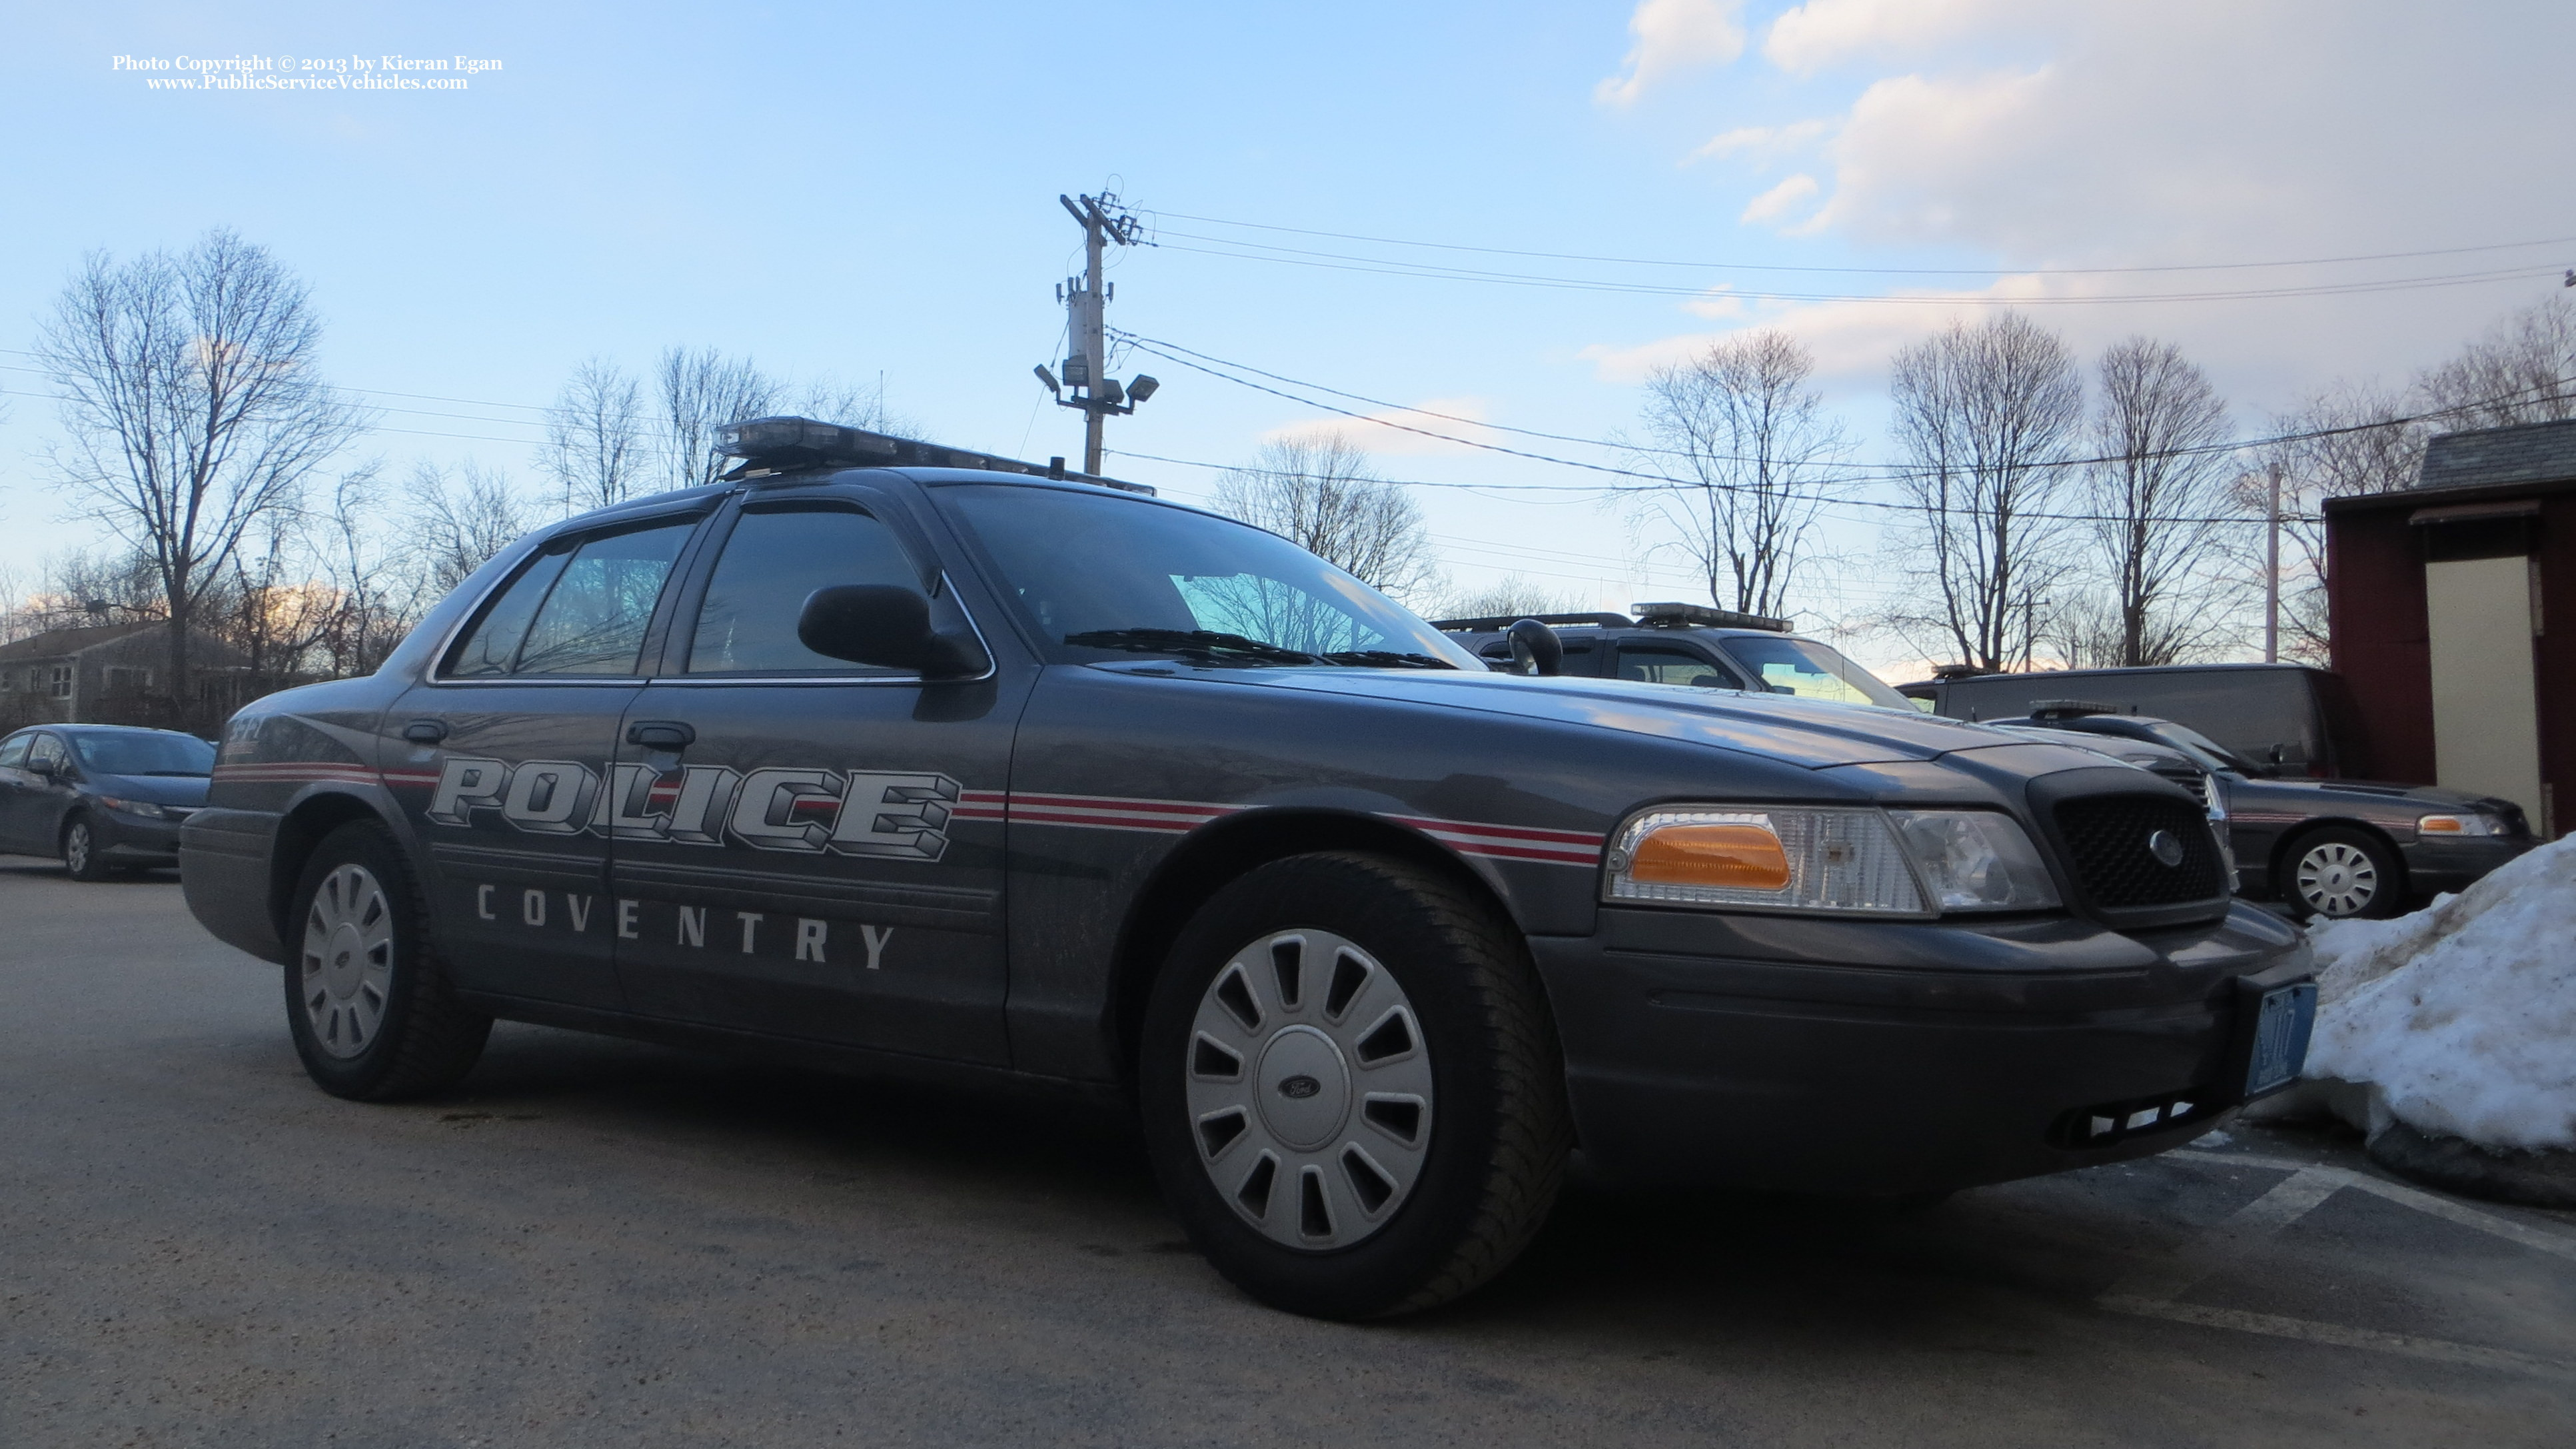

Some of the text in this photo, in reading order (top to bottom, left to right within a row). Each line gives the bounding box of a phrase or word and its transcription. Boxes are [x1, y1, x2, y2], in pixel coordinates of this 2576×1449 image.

[425, 756, 963, 861] POLICE
[477, 883, 894, 970] COVENTRY
[1285, 1080, 1313, 1094] Ford
